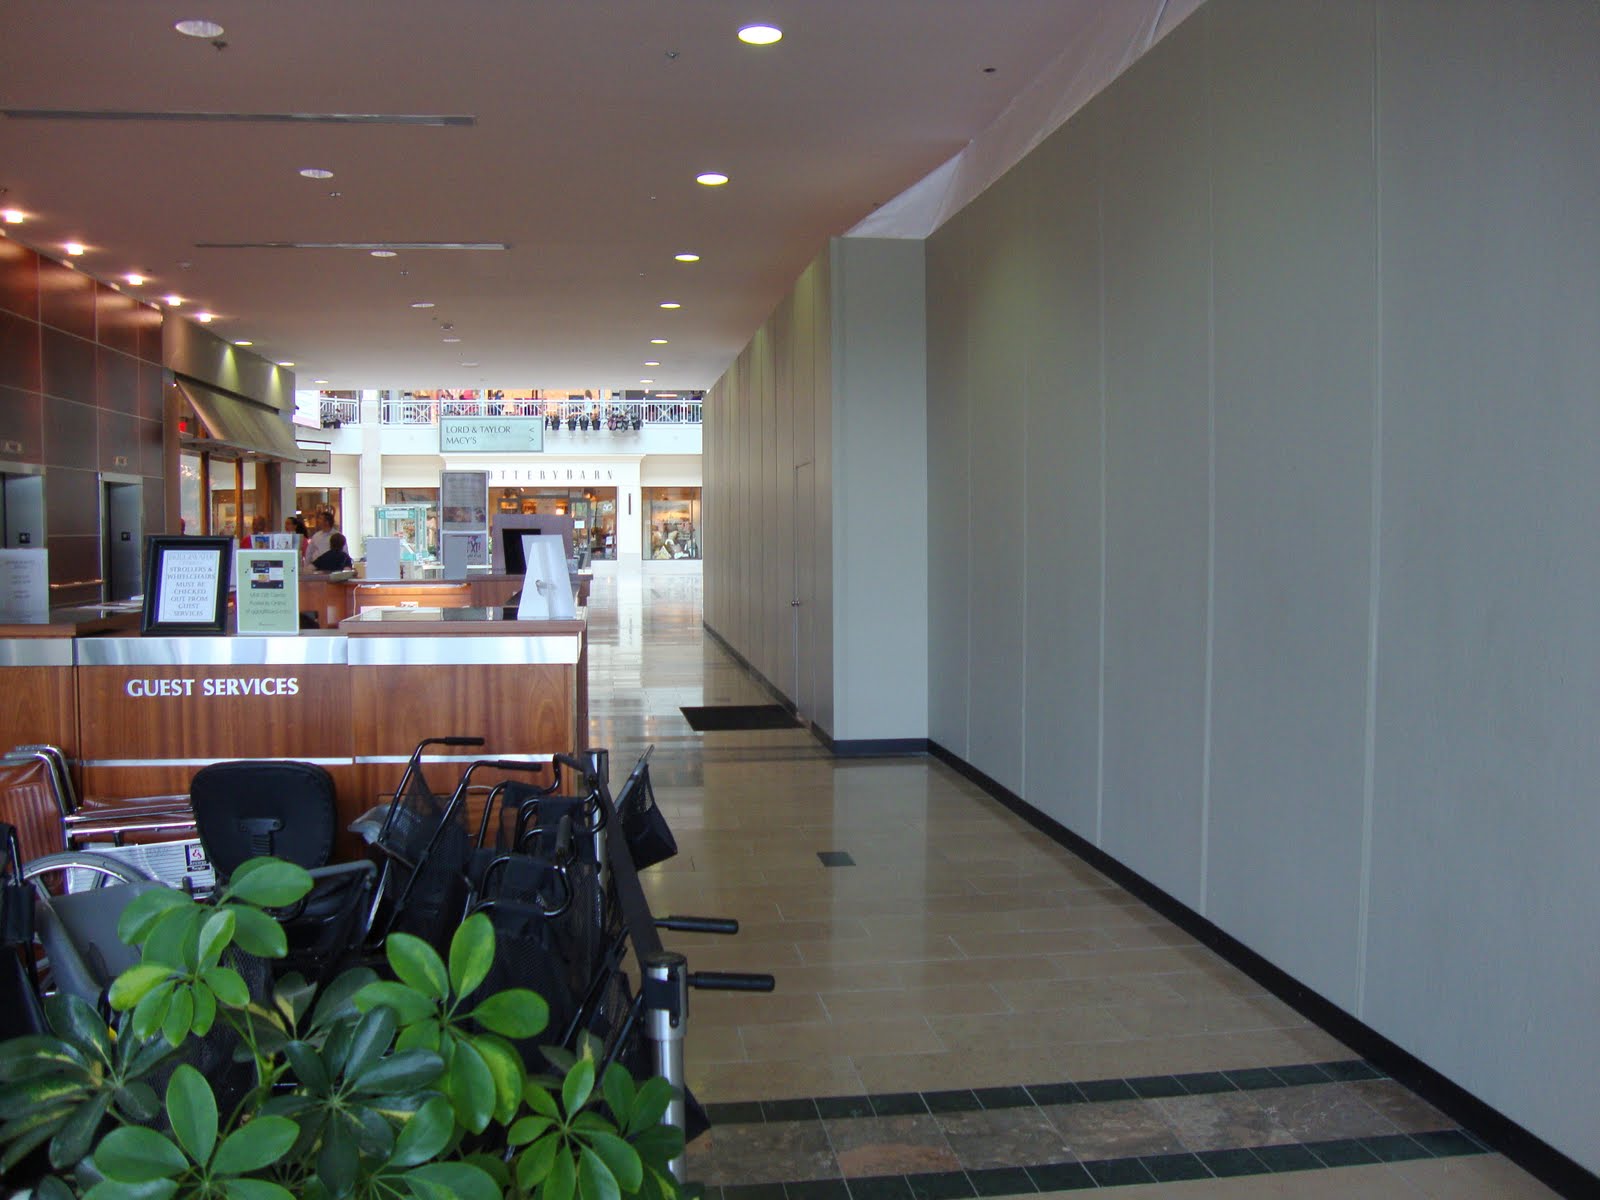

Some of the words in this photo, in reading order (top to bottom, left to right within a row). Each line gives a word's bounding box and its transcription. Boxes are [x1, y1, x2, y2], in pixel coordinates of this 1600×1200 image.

[446, 426, 470, 434] LORD
[471, 426, 478, 434] &
[480, 426, 511, 434] TAYLOR
[446, 436, 477, 445] MACY'S
[127, 679, 195, 697] GUEST
[203, 678, 300, 696] SERVICES
